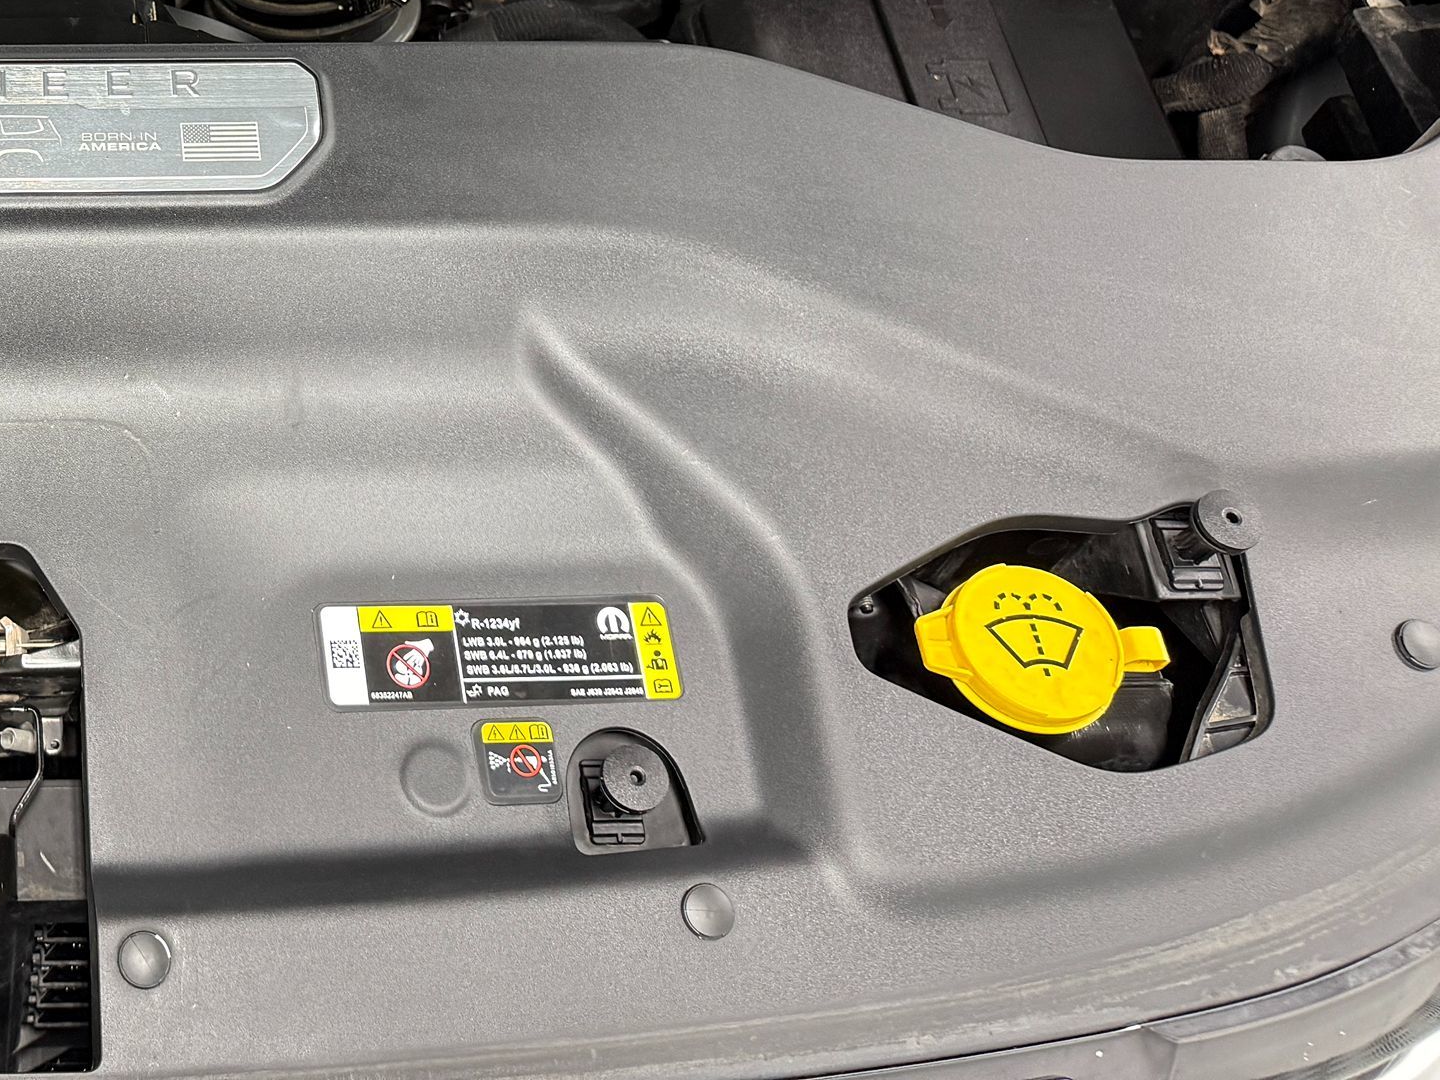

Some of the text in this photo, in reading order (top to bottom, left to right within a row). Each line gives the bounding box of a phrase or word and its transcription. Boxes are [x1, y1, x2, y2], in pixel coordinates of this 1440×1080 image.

[81, 132, 157, 141] BORN IN
[79, 142, 162, 151] AMERICA
[471, 618, 520, 631] R-1234yf
[462, 636, 485, 647] LWB
[486, 636, 507, 647] 3.0L
[532, 637, 540, 648] g
[571, 635, 585, 647] lb)
[464, 649, 488, 661] SWB
[535, 651, 543, 661] g
[573, 648, 587, 660] lb)
[466, 664, 490, 675] SWB
[581, 665, 589, 674] g
[619, 662, 634, 673] lb)
[487, 686, 509, 697] PAG
[570, 688, 586, 697] SAE
